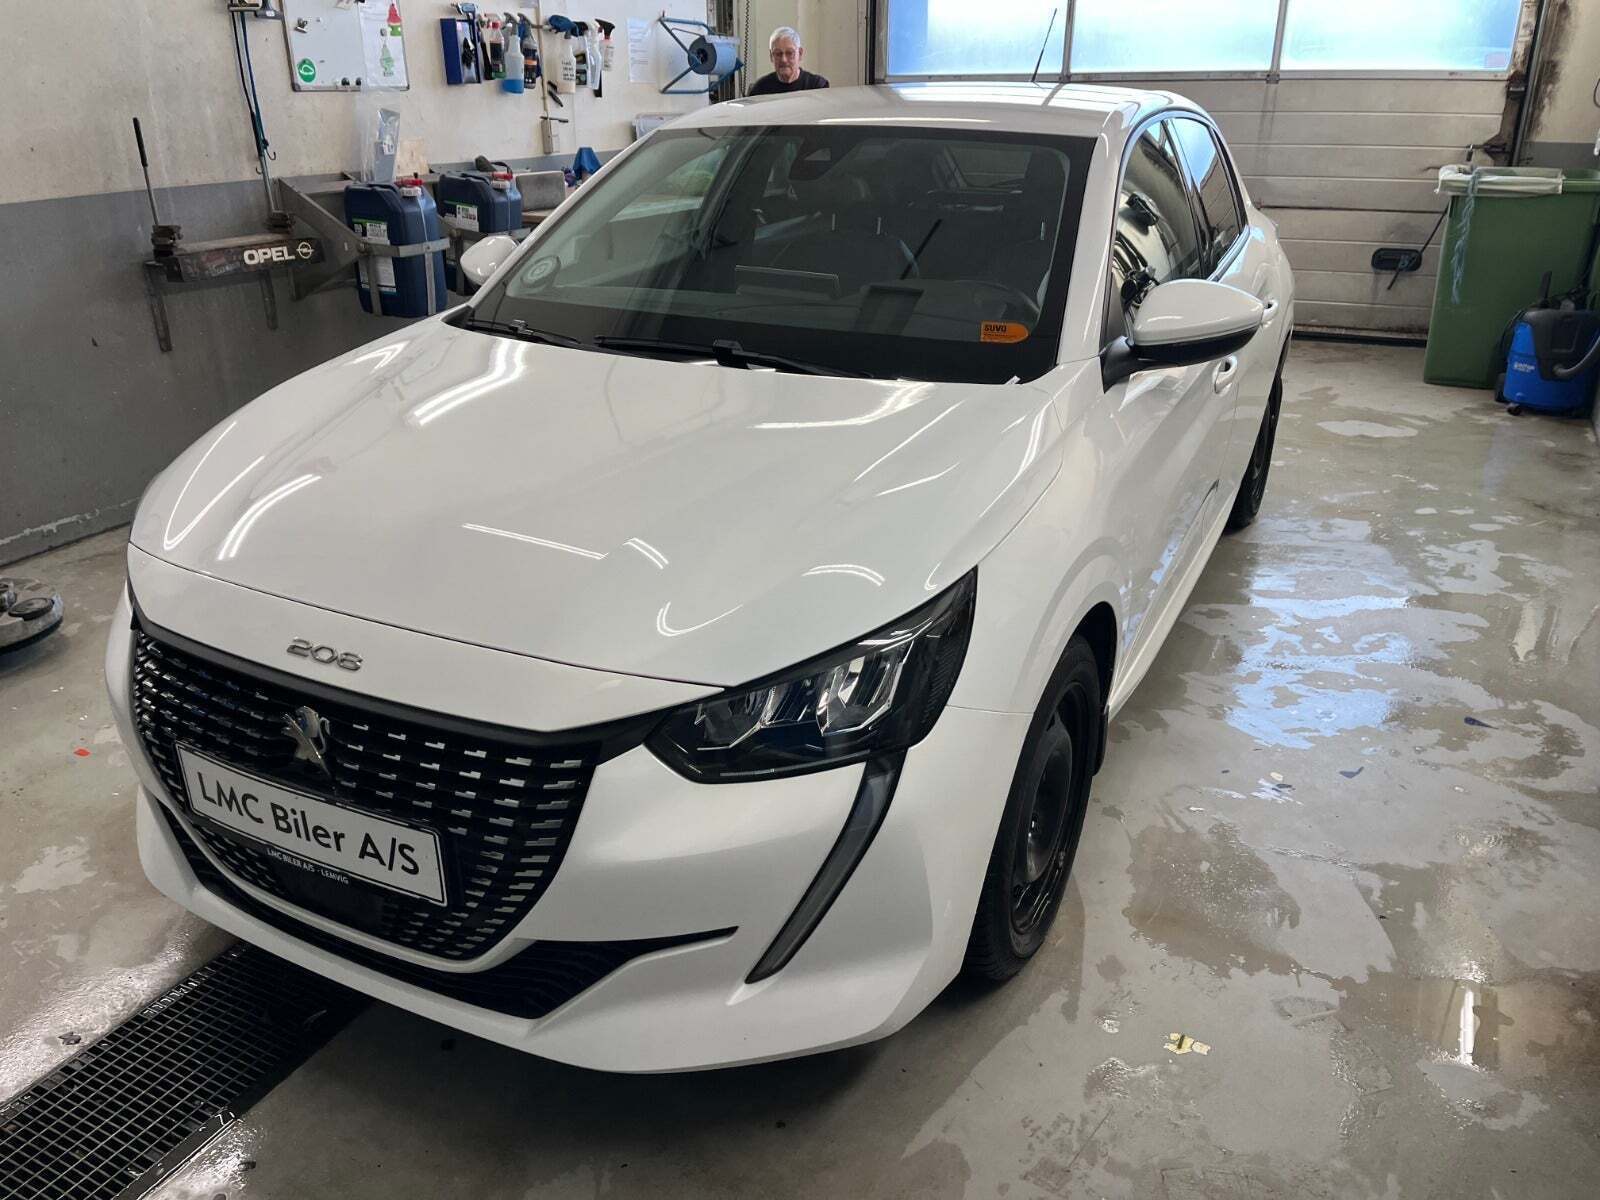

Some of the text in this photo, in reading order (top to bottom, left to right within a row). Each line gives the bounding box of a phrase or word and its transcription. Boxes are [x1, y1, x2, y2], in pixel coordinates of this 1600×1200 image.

[243, 246, 296, 265] OPEL
[286, 638, 363, 672] 208
[196, 771, 420, 876] LMC Biler A/S
[266, 848, 282, 860] LMC
[282, 854, 302, 869] BILER
[302, 862, 316, 873] A/S
[321, 869, 349, 885] LEMVIG
